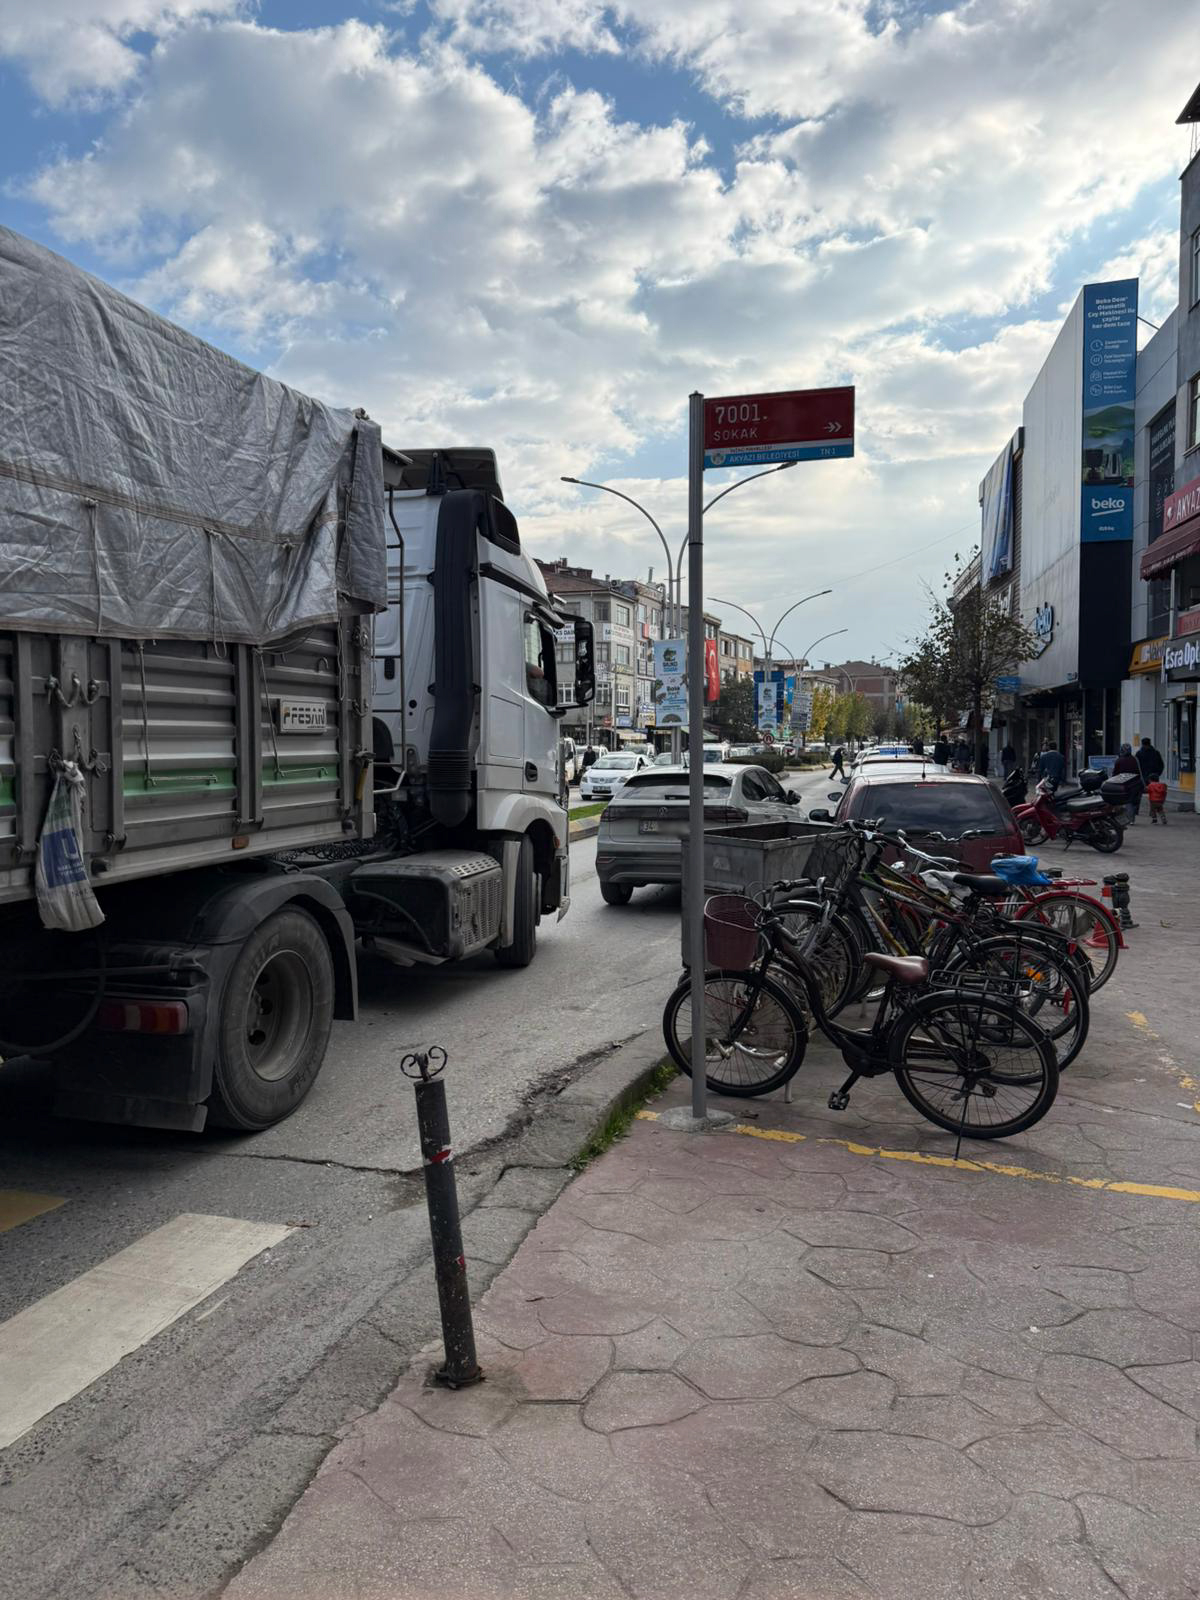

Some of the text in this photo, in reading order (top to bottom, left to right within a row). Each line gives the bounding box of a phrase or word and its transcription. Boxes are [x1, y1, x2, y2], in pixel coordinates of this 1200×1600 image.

[714, 404, 768, 424] 7001.
[713, 428, 758, 442] SOKAK
[730, 452, 755, 463] AKYAZI
[1091, 497, 1125, 509] beko
[1165, 647, 1184, 669] Esra
